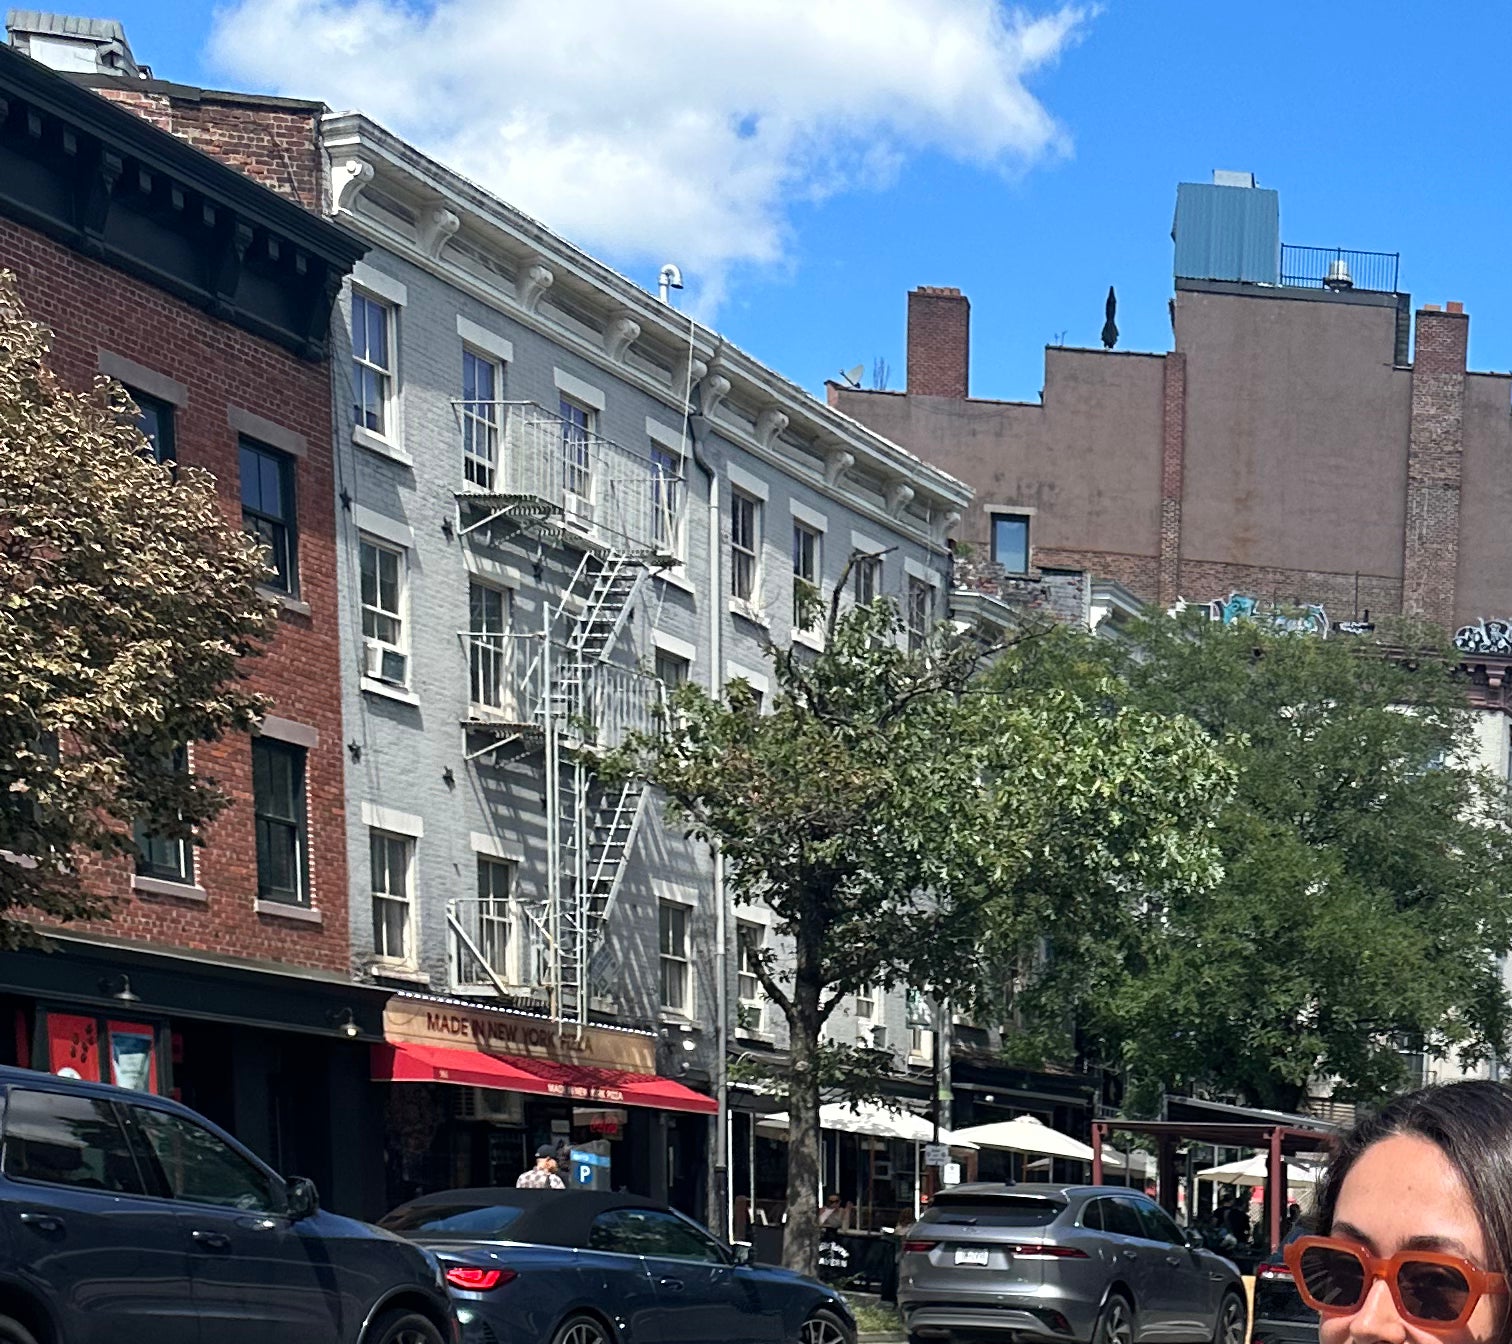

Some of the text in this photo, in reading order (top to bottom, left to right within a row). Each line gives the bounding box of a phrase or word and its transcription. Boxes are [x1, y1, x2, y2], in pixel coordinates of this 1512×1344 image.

[427, 1012, 468, 1036] MADE
[472, 1020, 485, 1039] IN
[488, 1023, 518, 1042] NEW
[521, 1026, 557, 1048] YORK
[580, 1165, 591, 1183] P
